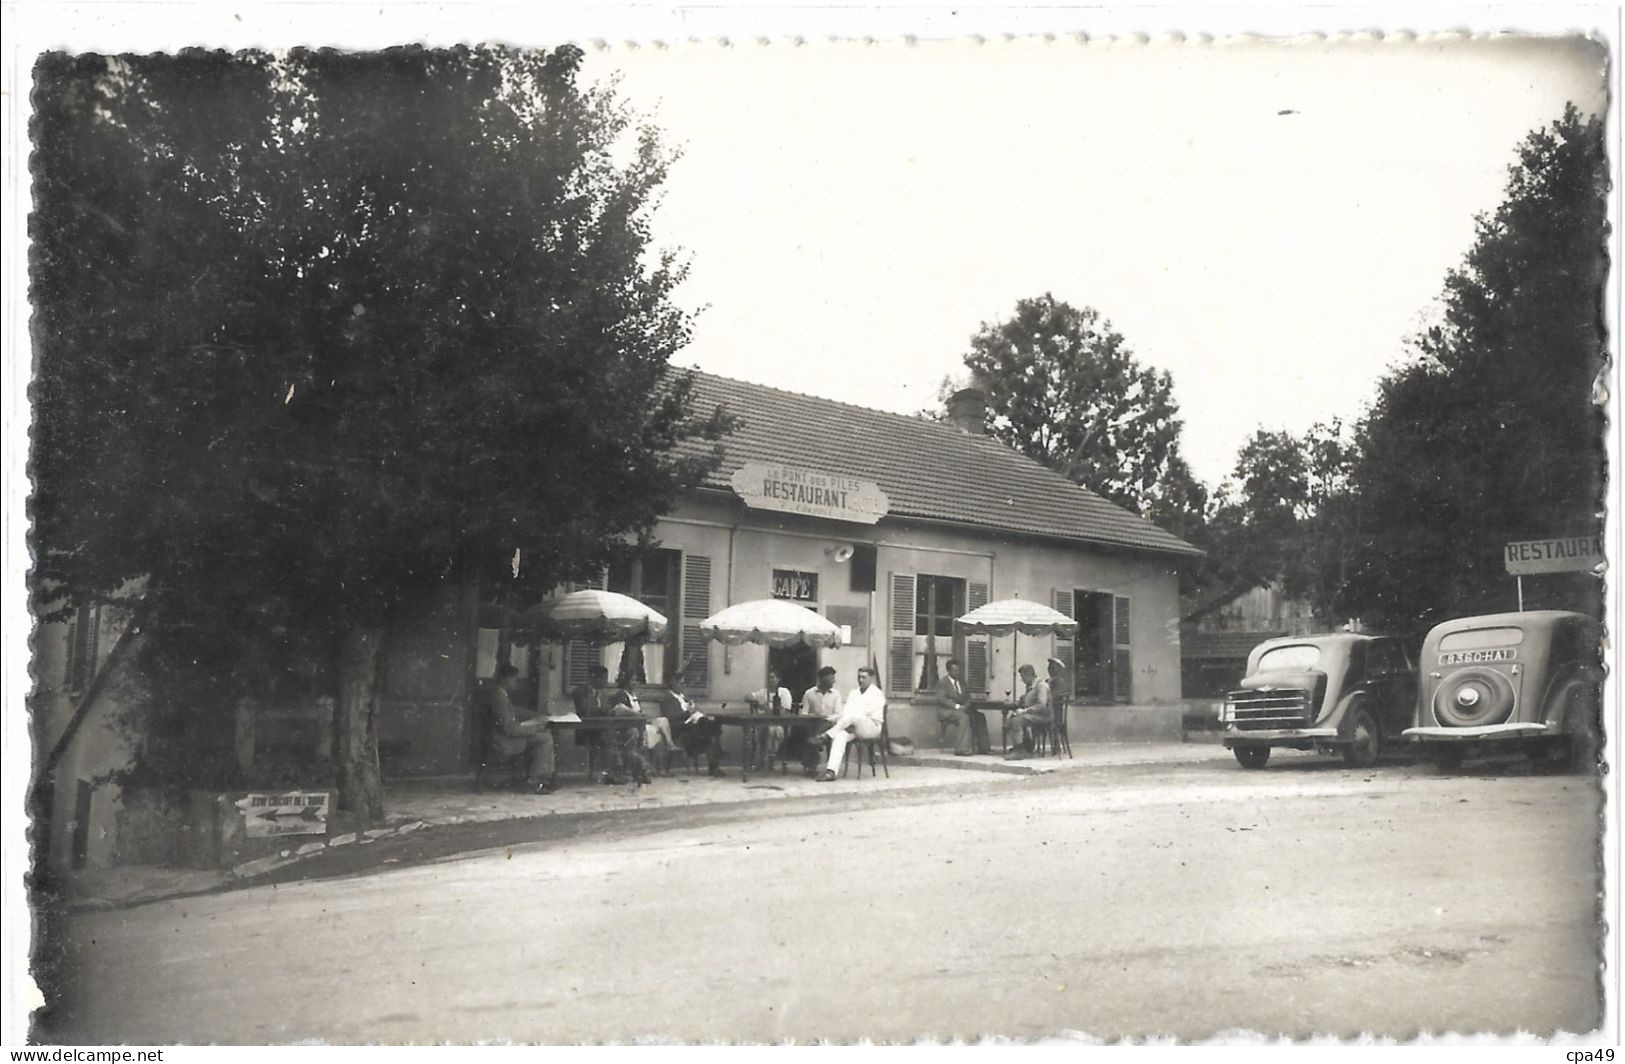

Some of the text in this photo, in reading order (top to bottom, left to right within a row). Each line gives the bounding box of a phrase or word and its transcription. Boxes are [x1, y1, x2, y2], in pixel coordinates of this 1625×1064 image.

[831, 478, 859, 492] PILES
[763, 480, 847, 508] RESTAURANT
[269, 795, 292, 806] CIRCUIT
[294, 795, 302, 806] DE
